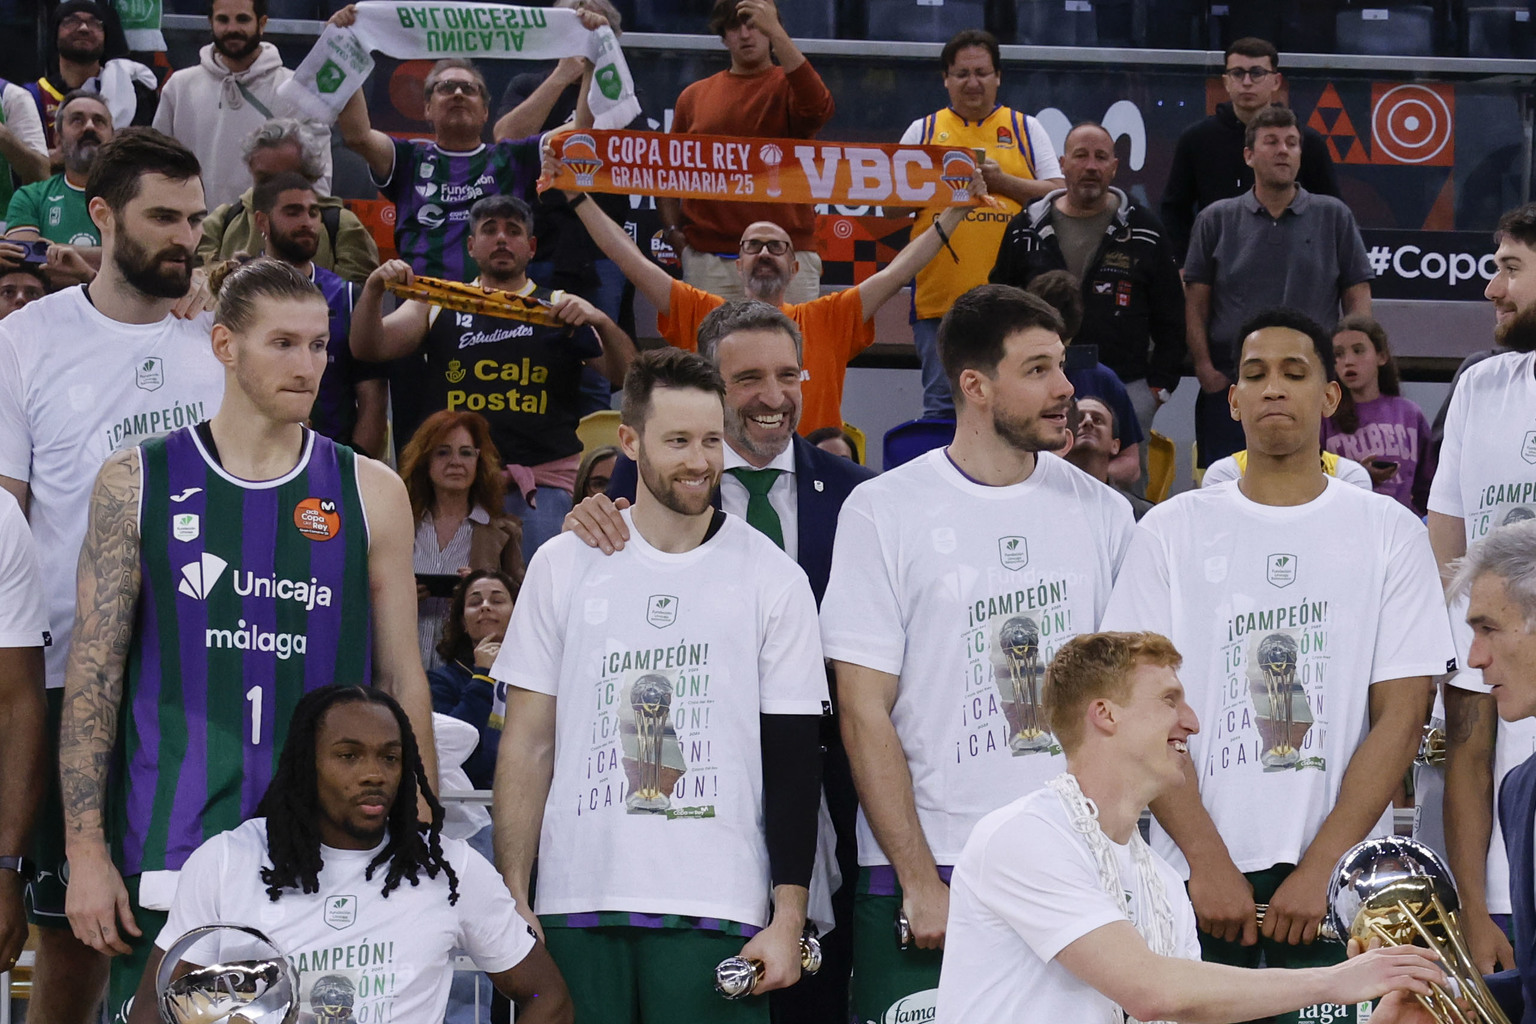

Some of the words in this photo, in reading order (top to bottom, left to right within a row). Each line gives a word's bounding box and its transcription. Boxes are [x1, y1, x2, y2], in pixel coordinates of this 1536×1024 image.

[607, 136, 662, 166] COPA
[670, 139, 707, 169] DEL
[713, 142, 750, 172] REY
[611, 166, 654, 190] GRAN
[657, 170, 727, 195] CANARIA
[795, 145, 935, 200] VBC
[458, 324, 533, 349] Estudiantes
[474, 358, 548, 386] Caja
[447, 390, 547, 414] Postal
[233, 569, 332, 611] Unicaja
[968, 578, 1067, 628] ¡CAMPEÓN!
[1228, 597, 1328, 641] ¡CAMPEÓN!
[601, 638, 709, 678] ¡CAMPEÓN!
[246, 685, 262, 744] 1
[288, 938, 394, 972] AMPEÓN!
[894, 996, 936, 1024] fama
